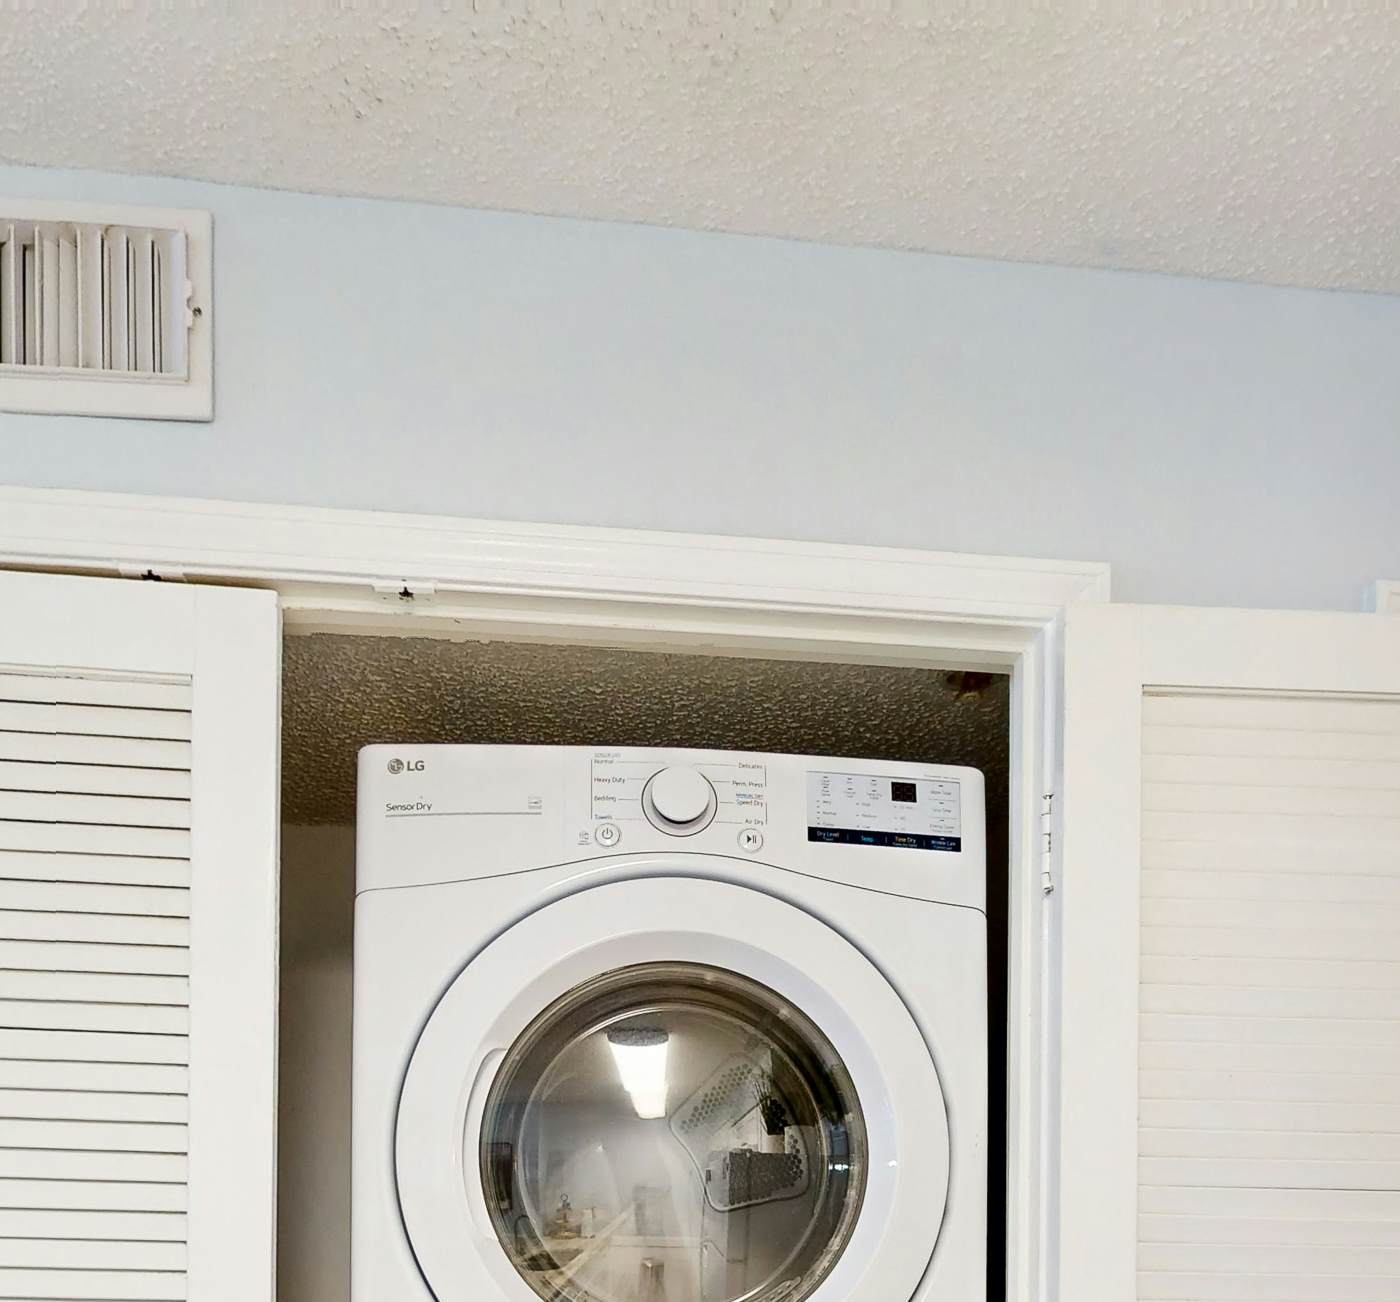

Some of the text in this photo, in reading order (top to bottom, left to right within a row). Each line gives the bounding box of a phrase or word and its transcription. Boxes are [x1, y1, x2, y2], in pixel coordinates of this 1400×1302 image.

[406, 760, 425, 772] LG
[386, 802, 433, 812] Sensor Dry
